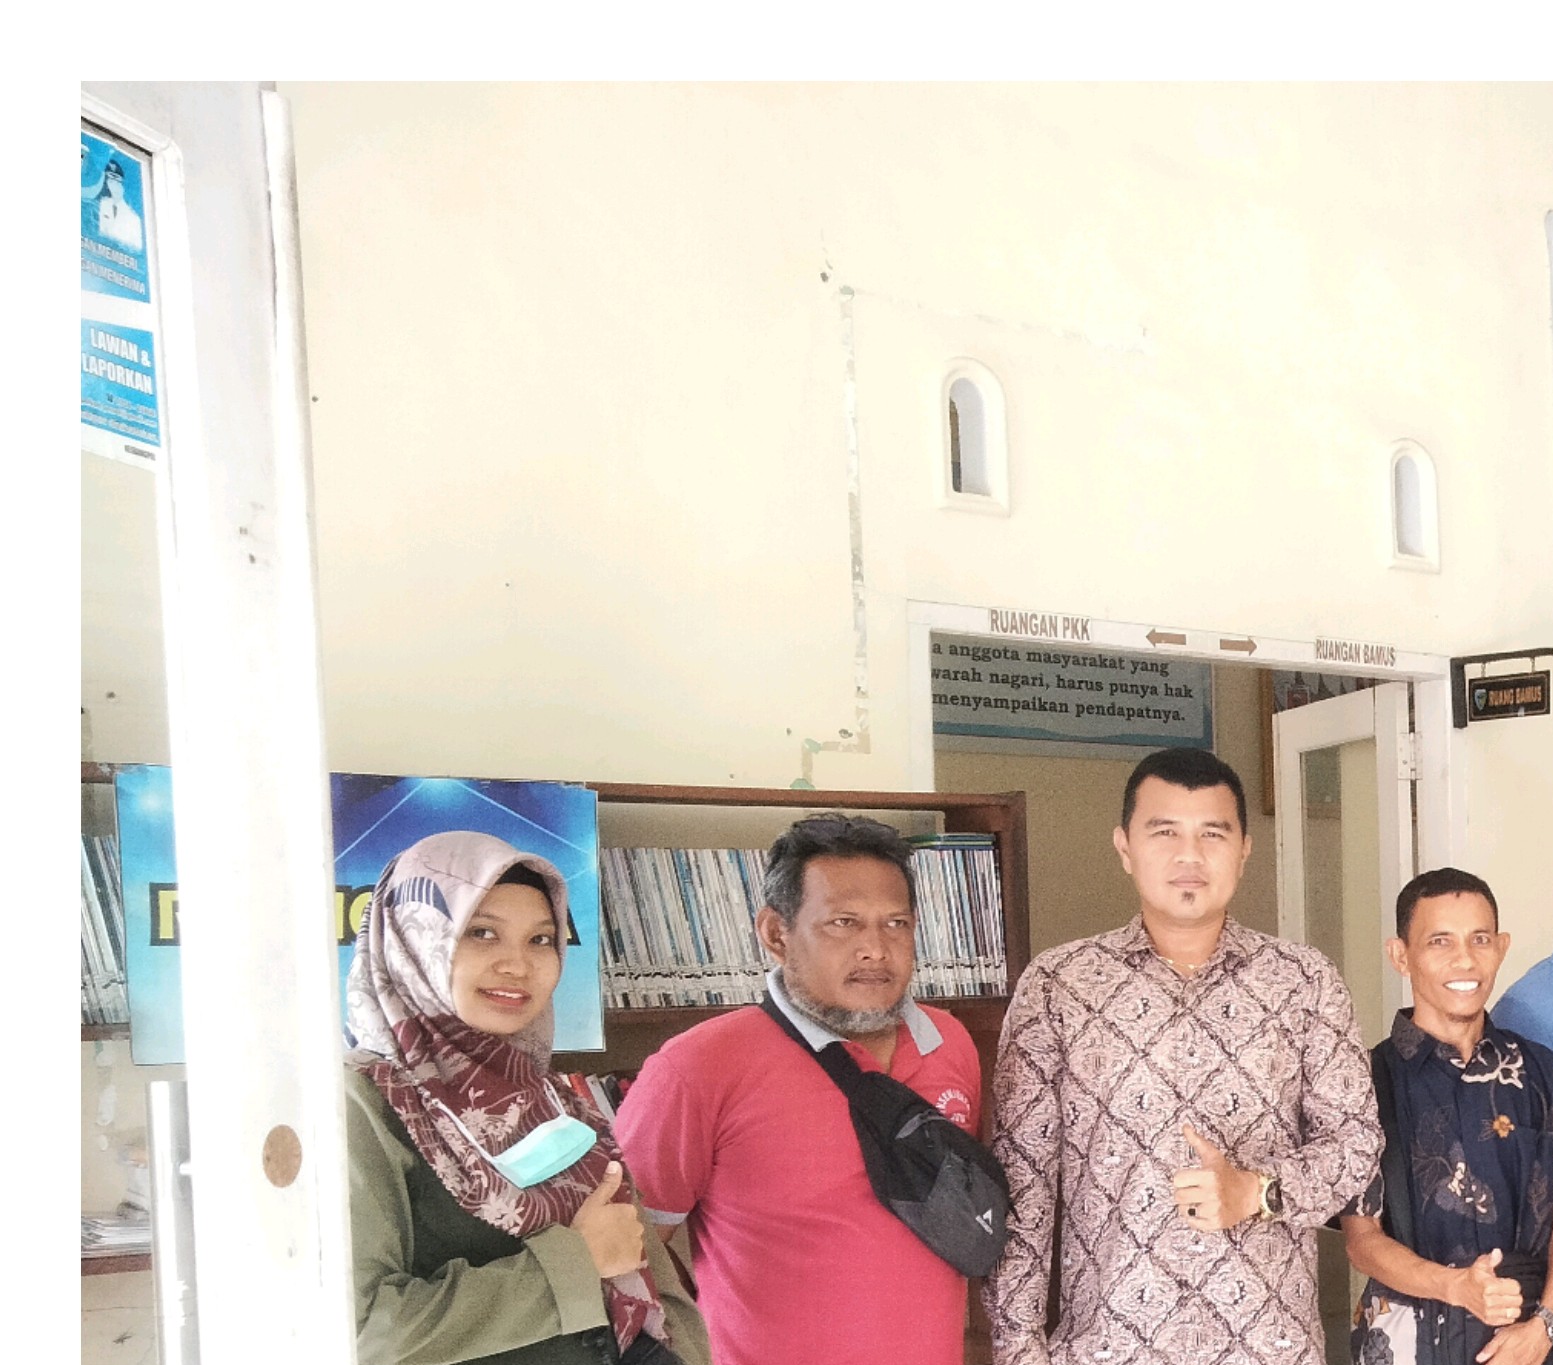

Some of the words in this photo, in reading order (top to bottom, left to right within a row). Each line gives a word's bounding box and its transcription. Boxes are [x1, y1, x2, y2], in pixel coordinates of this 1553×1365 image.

[91, 328, 138, 363] LAWAN
[142, 352, 151, 367] &
[82, 353, 154, 395] LAPORKAN
[990, 609, 1058, 638] RUANGAN
[1062, 616, 1090, 641] PKK
[948, 644, 1021, 662] anggota
[1026, 650, 1126, 671] masyarakat
[1130, 659, 1169, 677] yang
[1316, 639, 1360, 663] RUANGAN
[1363, 643, 1396, 667] BAMUS
[989, 673, 1050, 690] nagari,
[1056, 675, 1104, 692] harus
[1109, 681, 1158, 698] punya
[1164, 683, 1194, 699] hak
[932, 693, 1069, 714] menyampaikan
[1075, 701, 1186, 722] pendapatnya.
